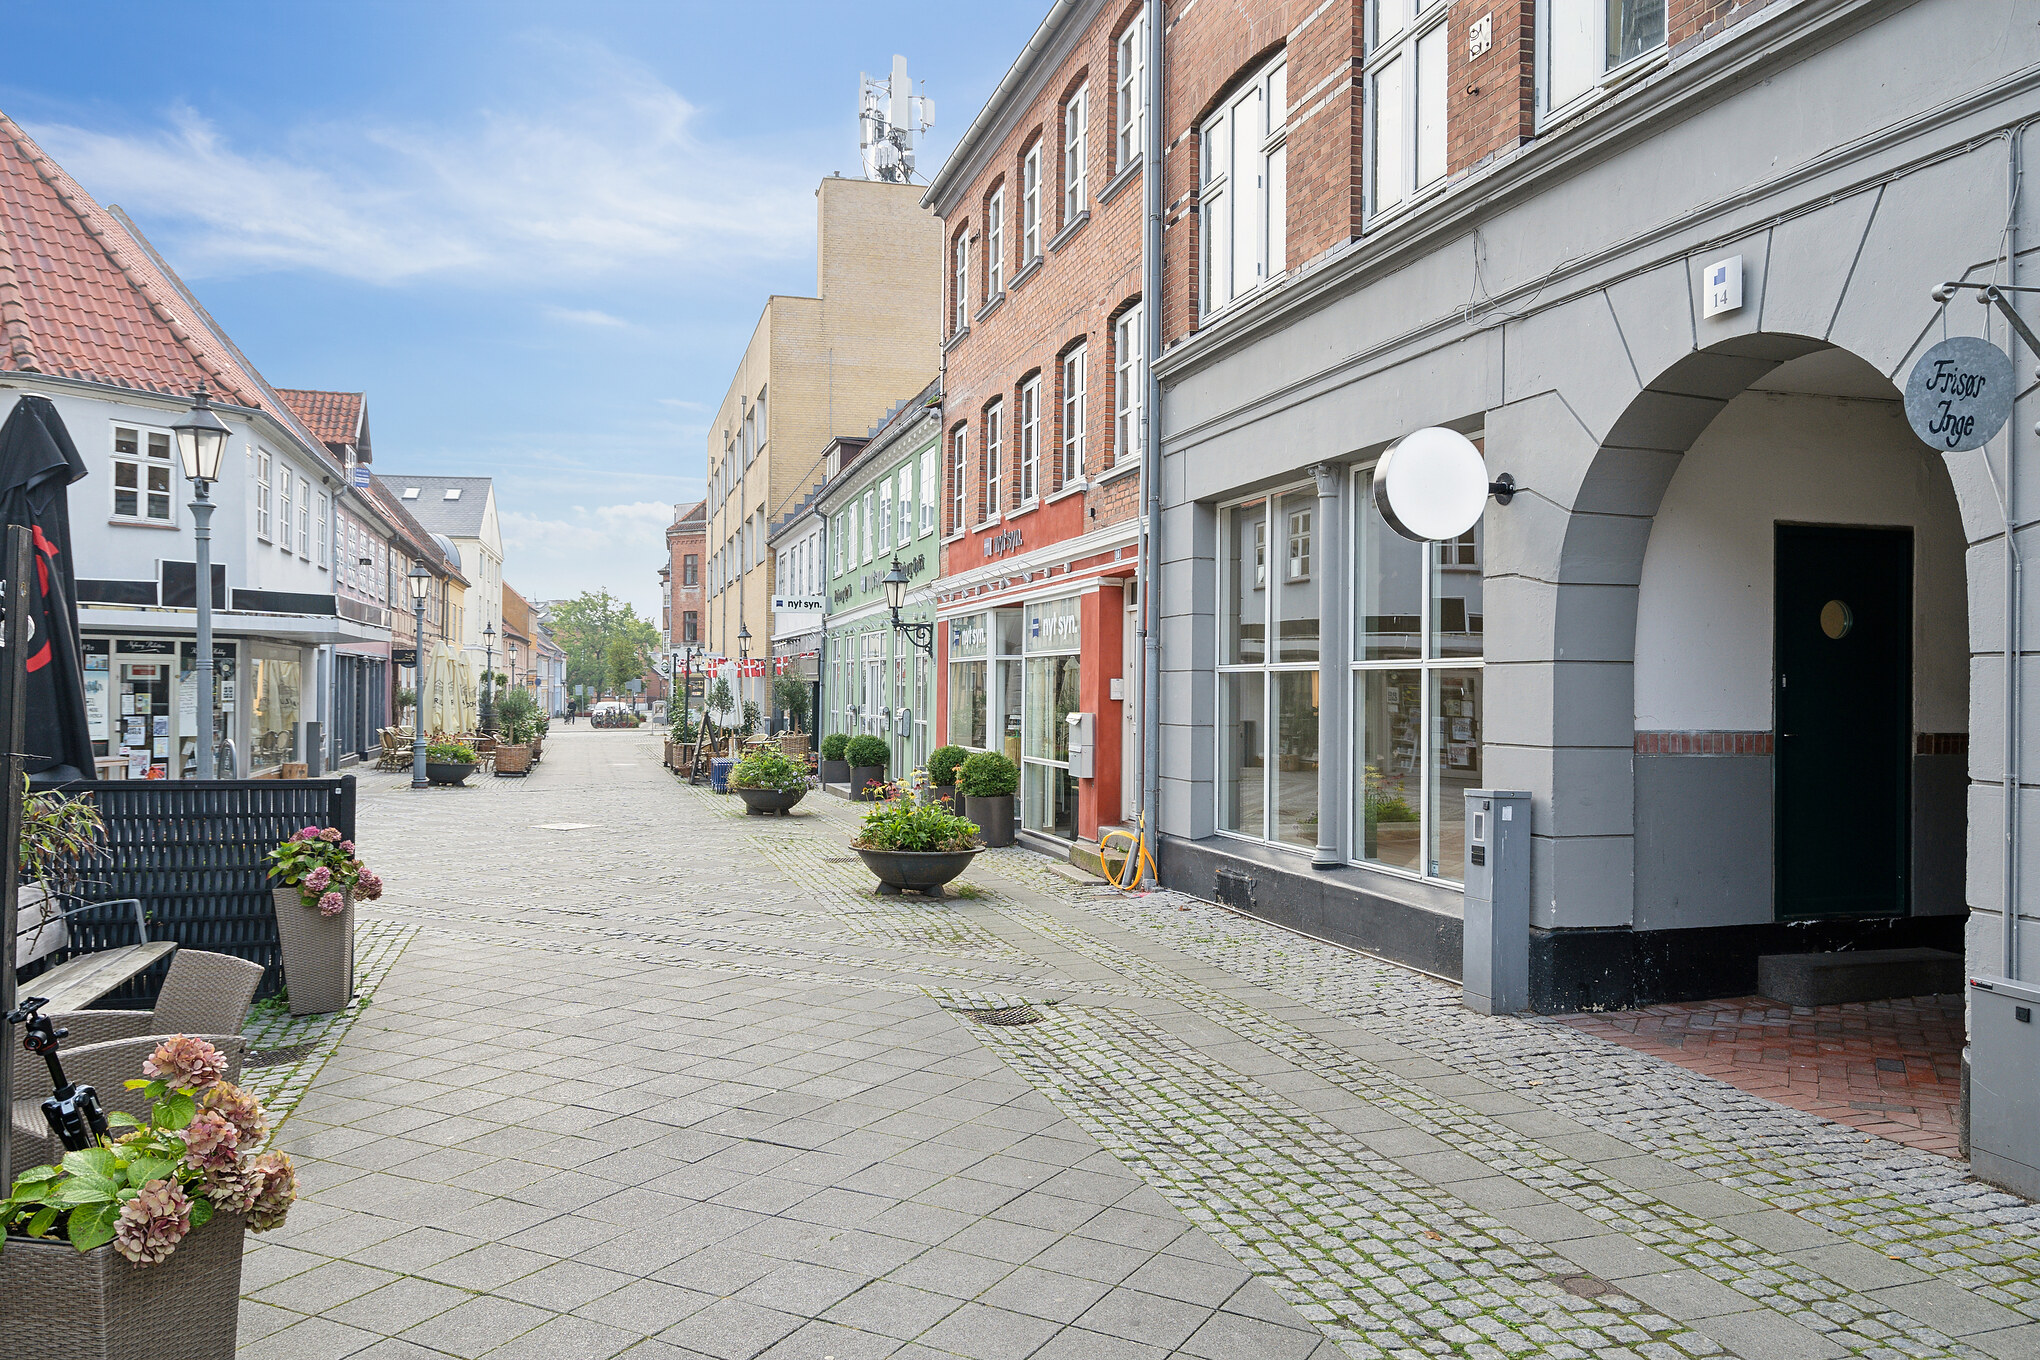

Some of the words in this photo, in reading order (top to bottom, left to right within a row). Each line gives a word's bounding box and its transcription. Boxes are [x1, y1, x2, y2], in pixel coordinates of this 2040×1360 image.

[1713, 289, 1728, 308] 14
[1926, 360, 1986, 401] Frisør
[1928, 400, 1975, 448] Inge
[994, 529, 1006, 556] nyt
[1006, 529, 1023, 553] syn.
[787, 600, 802, 610] nyt
[803, 601, 822, 610] syn.
[961, 625, 972, 650] nyt
[972, 627, 985, 648] syn.
[1042, 612, 1057, 641] nyt
[1058, 615, 1077, 640] syn.
